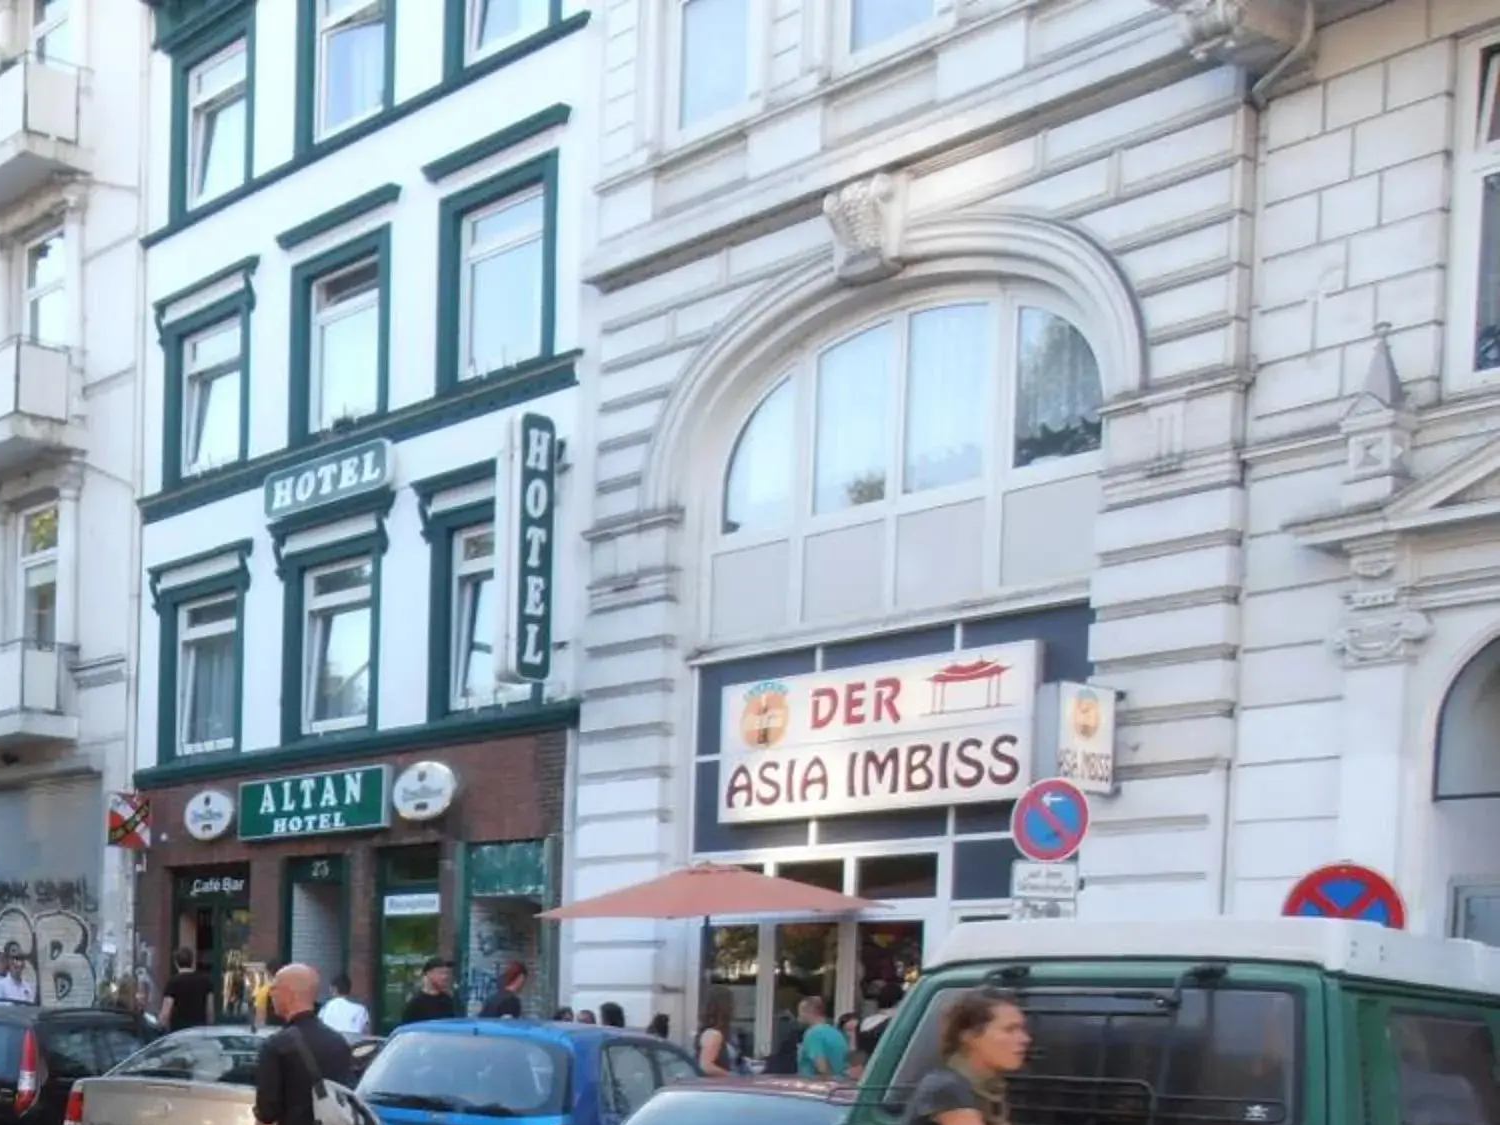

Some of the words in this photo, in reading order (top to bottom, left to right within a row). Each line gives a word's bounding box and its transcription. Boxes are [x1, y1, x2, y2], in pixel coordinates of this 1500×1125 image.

[272, 451, 381, 510] HOTEL
[522, 428, 551, 665] HOTEL
[809, 677, 902, 731] DER
[259, 771, 364, 814] ALTAN
[725, 757, 829, 809] ASIA
[846, 734, 1021, 798] IMBISS
[272, 811, 346, 835] HOTEL
[222, 876, 245, 894] Bar
